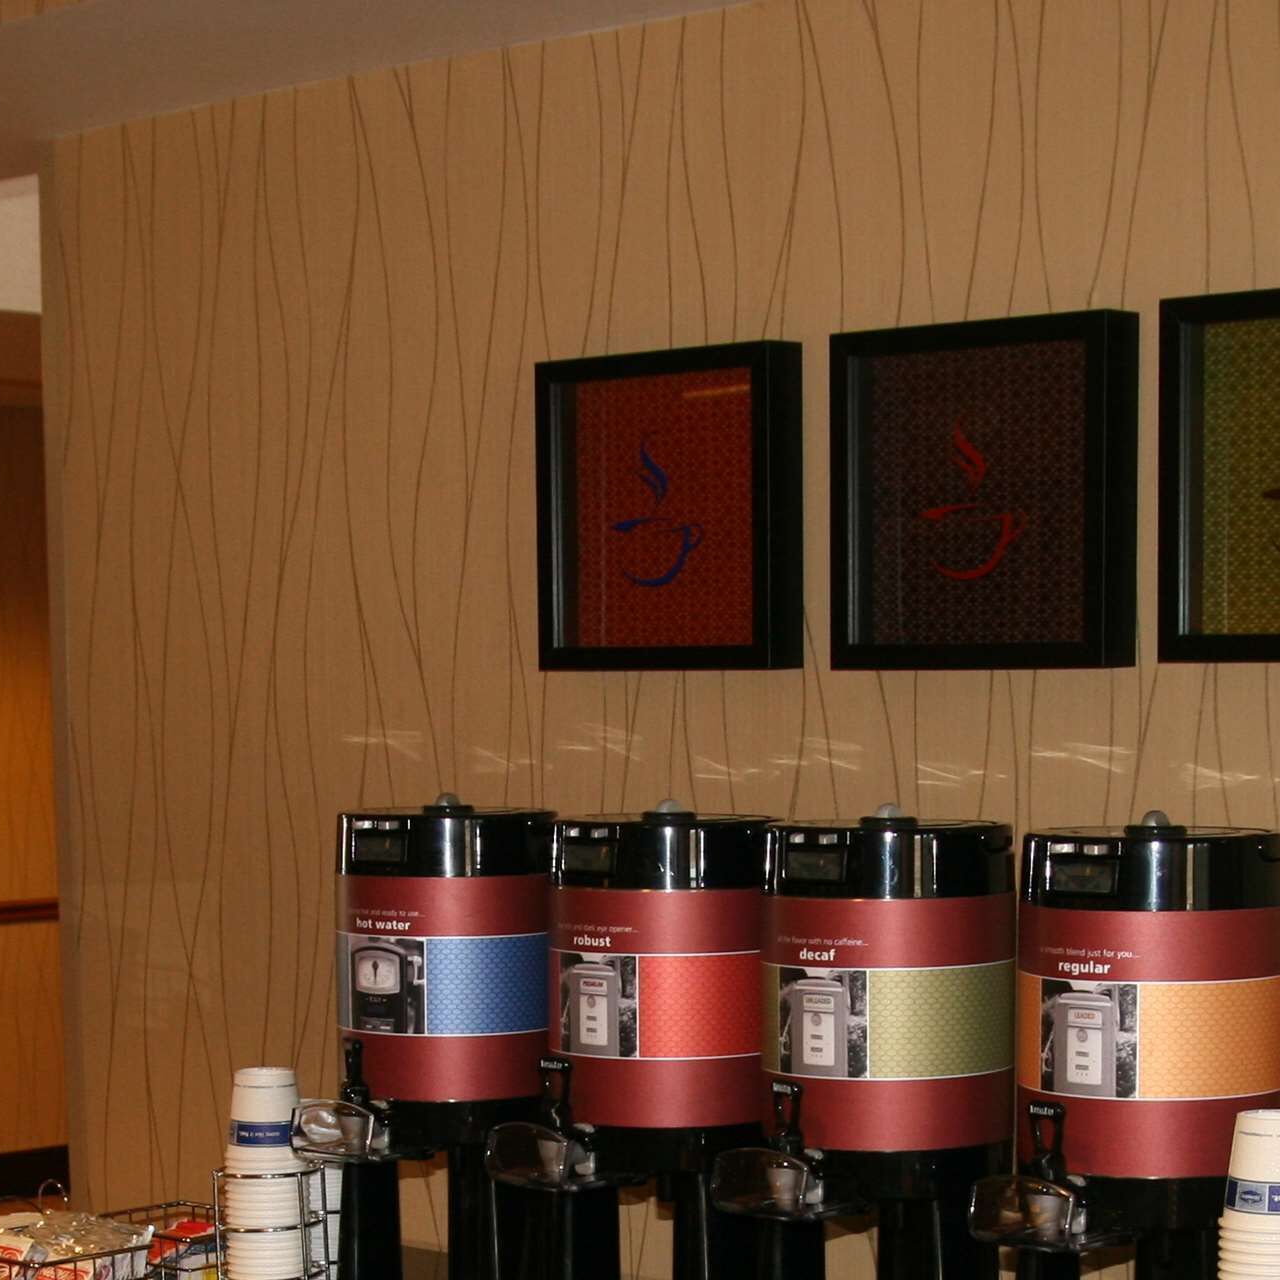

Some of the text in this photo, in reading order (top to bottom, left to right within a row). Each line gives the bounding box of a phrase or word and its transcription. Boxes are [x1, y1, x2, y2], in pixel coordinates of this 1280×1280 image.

[356, 917, 411, 931] hot water
[573, 934, 612, 947] robust
[799, 948, 837, 961] decaf
[1058, 961, 1111, 976] regular
